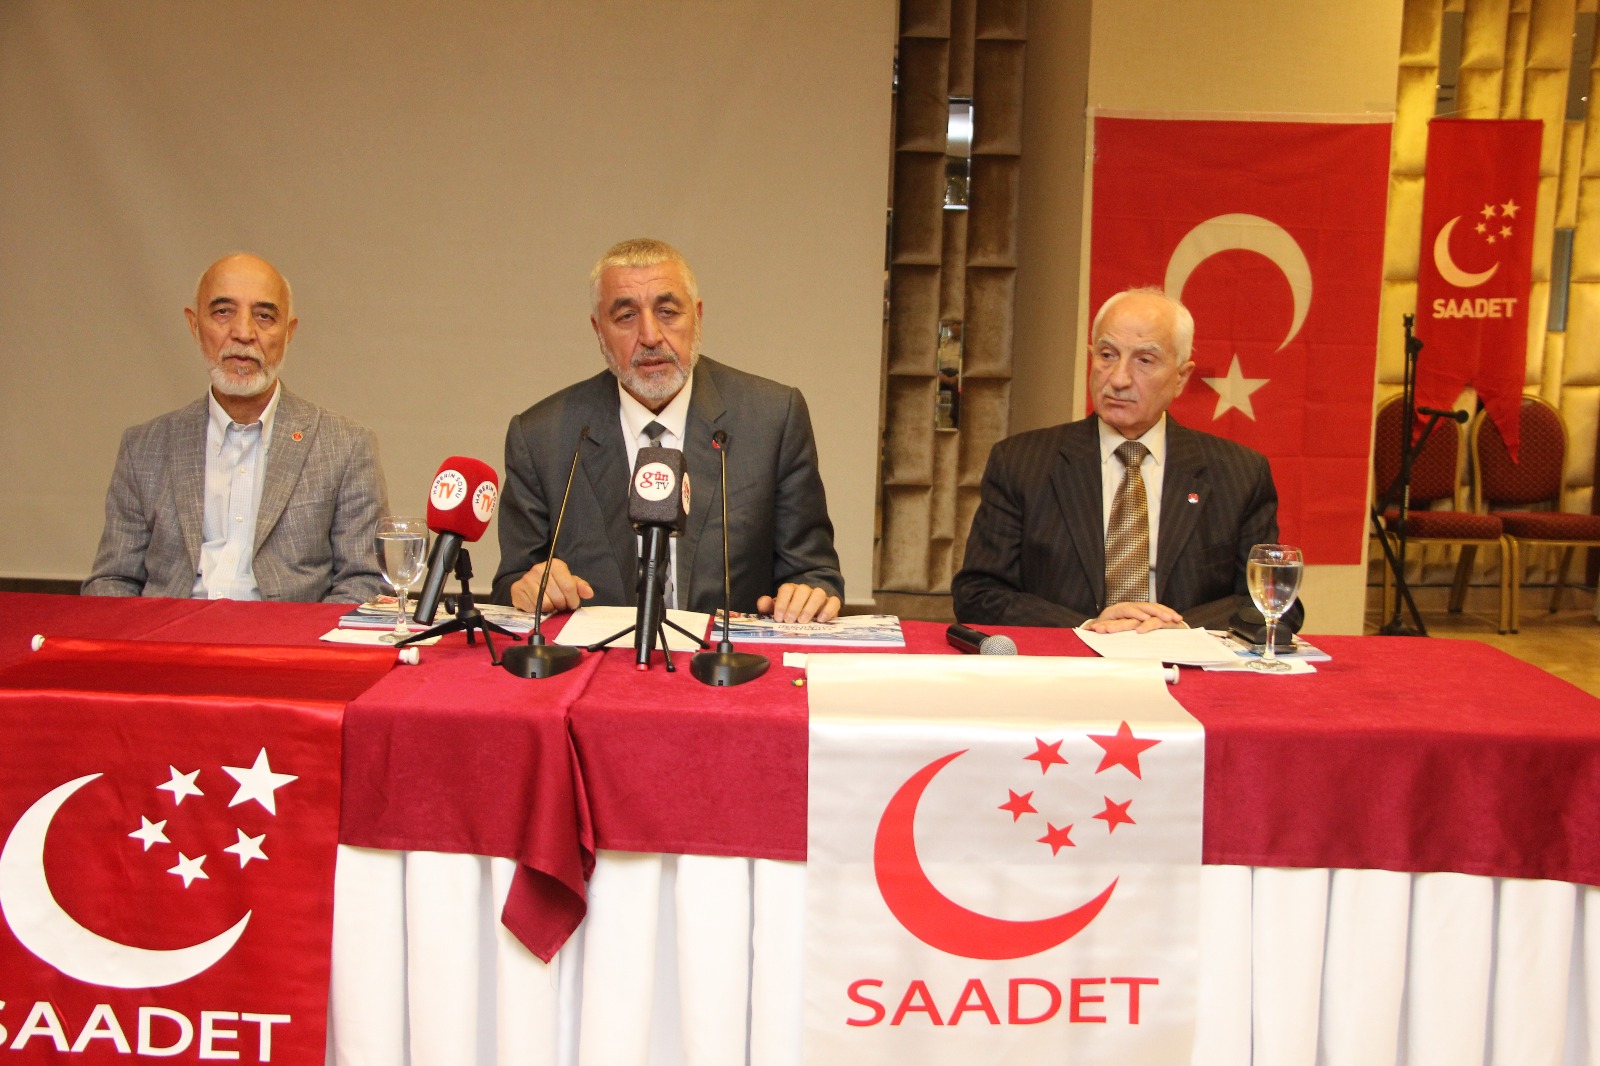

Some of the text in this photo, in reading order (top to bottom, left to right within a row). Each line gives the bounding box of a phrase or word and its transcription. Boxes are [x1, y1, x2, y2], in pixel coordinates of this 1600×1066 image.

[1432, 297, 1517, 318] SAADET
[455, 477, 463, 499] SONU
[640, 471, 668, 488] gün
[655, 481, 669, 490] TV
[439, 482, 456, 499] TV
[481, 493, 494, 512] TV
[846, 977, 1159, 1027] SAADET
[0, 1000, 291, 1062] AADET
